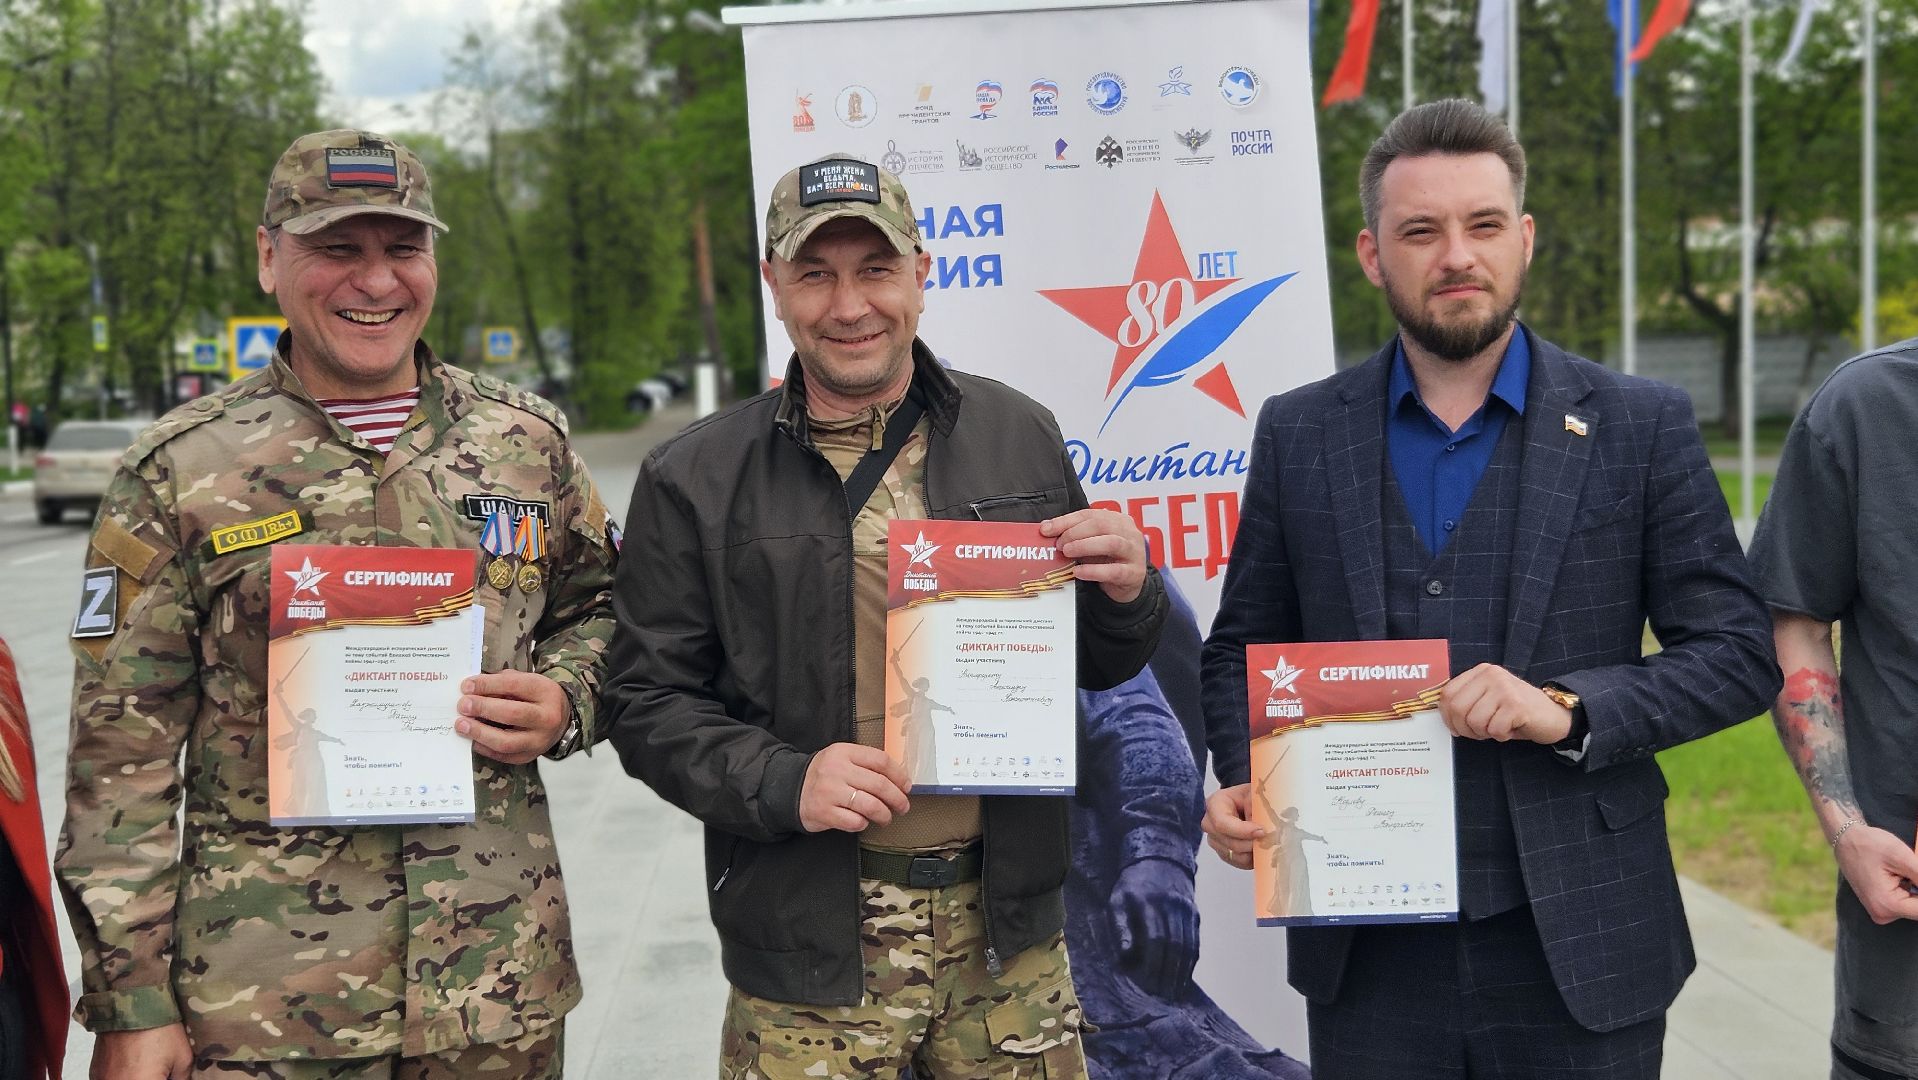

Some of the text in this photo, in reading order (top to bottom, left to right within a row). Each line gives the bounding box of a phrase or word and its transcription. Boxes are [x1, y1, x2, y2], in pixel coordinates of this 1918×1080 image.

[1231, 130, 1272, 143] ПОЧТА
[330, 149, 393, 158] РОССИЯ
[984, 145, 1030, 154] РОССИЙСКОЕ
[1232, 143, 1274, 156] РОССИИ
[984, 154, 1038, 162] ИСТОРИЧЕСКОЕ
[821, 165, 841, 176] МЕНЯ
[843, 166, 865, 176] ЖЕНА
[985, 162, 1022, 171] ОБЩЕСТВО
[806, 183, 823, 194] ВАМ
[825, 181, 844, 190] ВСЕМ
[1117, 251, 1238, 348] 80 ЛЕТ
[480, 500, 538, 520] ШАМАН
[267, 520, 293, 535] Rh+
[955, 544, 1056, 560] СЕРТИФИКАТ
[344, 571, 454, 586] СЕРТИФИКАТ
[904, 578, 938, 591] ПОБЕДЫ
[79, 576, 112, 628] Z
[288, 606, 326, 620] ПОБЕДЫ
[1007, 643, 1054, 654] ПОБЕДЫ»
[400, 671, 449, 682] ПОБЕДЫ»
[1319, 664, 1429, 681] СЕРТИФИКАТ
[1266, 704, 1303, 718] ПОБЕДЫ
[1380, 766, 1429, 777] ПОБЕДЫ»
[1327, 860, 1348, 868] чтобы
